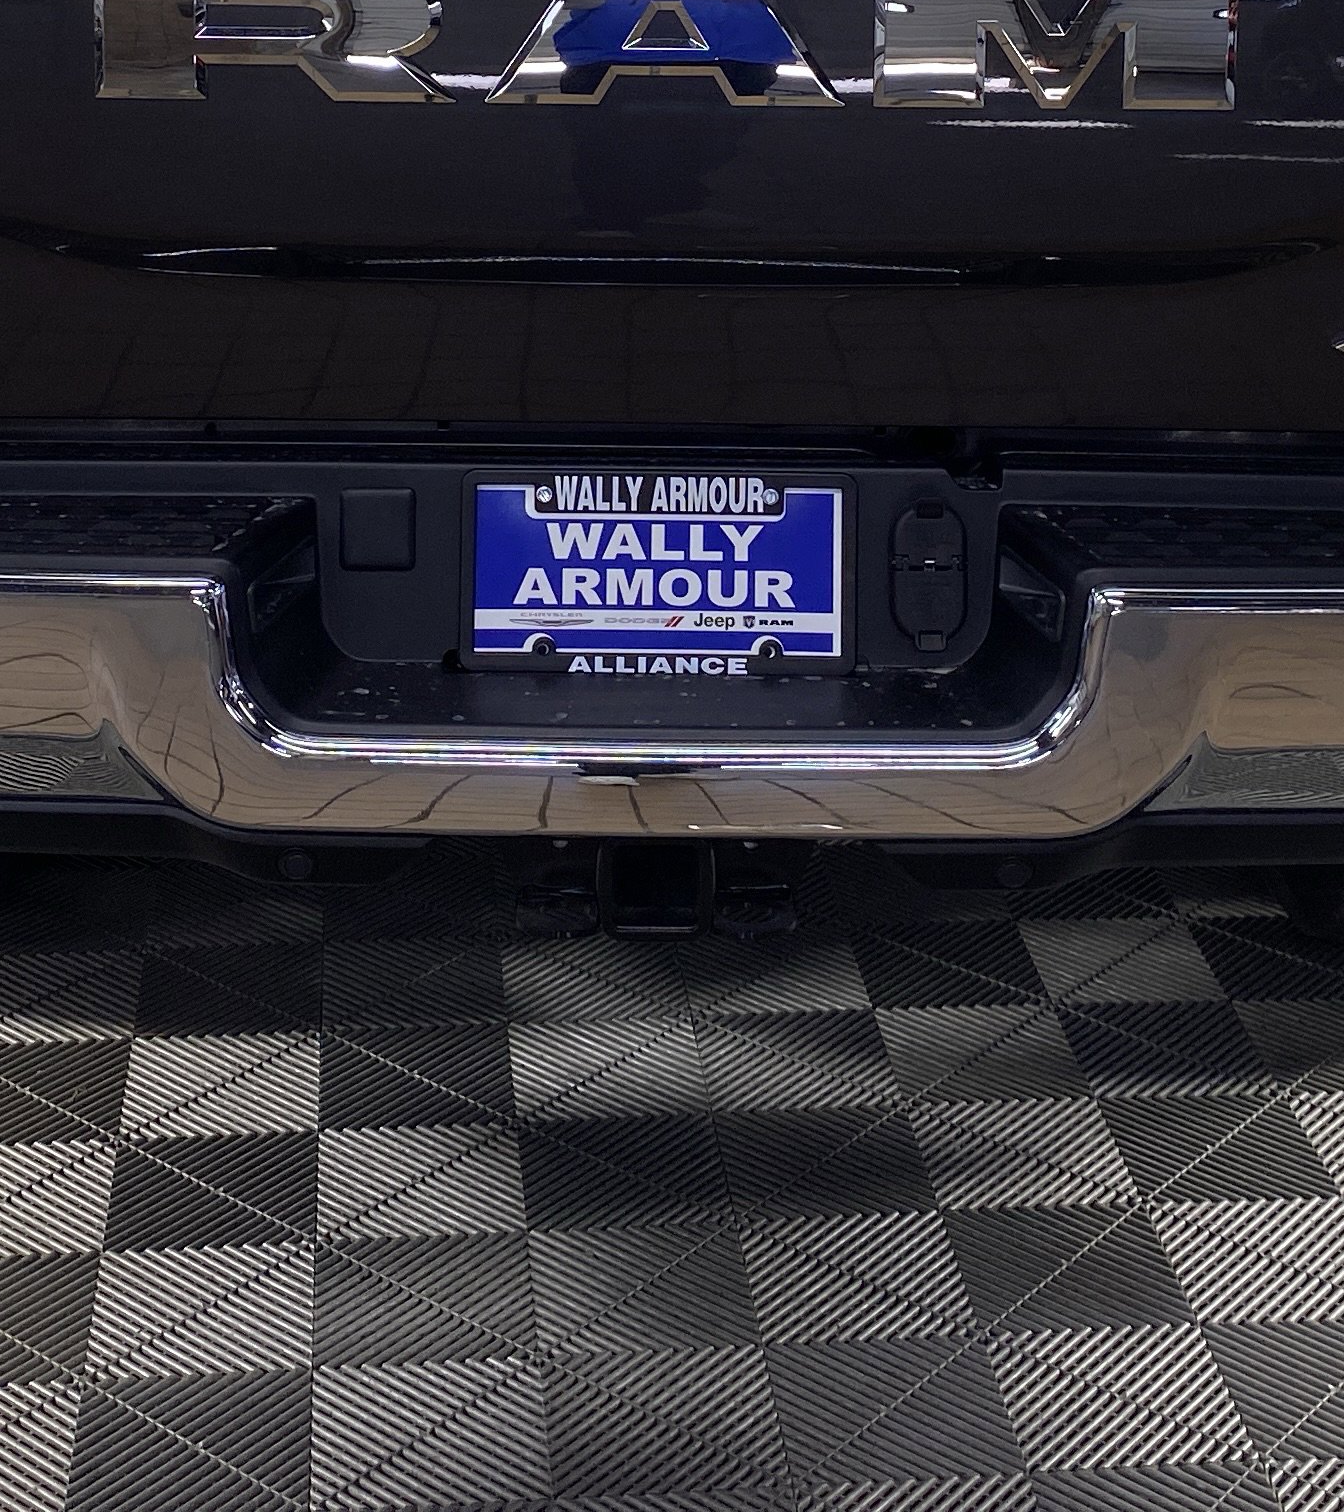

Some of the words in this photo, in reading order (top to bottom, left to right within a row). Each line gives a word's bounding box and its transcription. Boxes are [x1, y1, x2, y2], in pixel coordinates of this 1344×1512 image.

[554, 475, 644, 512] WALLY
[650, 476, 765, 514] ARMOUR
[546, 522, 765, 562] WALLY
[512, 567, 797, 609] ARMOUR
[693, 612, 736, 631] Jeep
[758, 619, 794, 627] RAM
[567, 654, 749, 676] ALLIANCE
